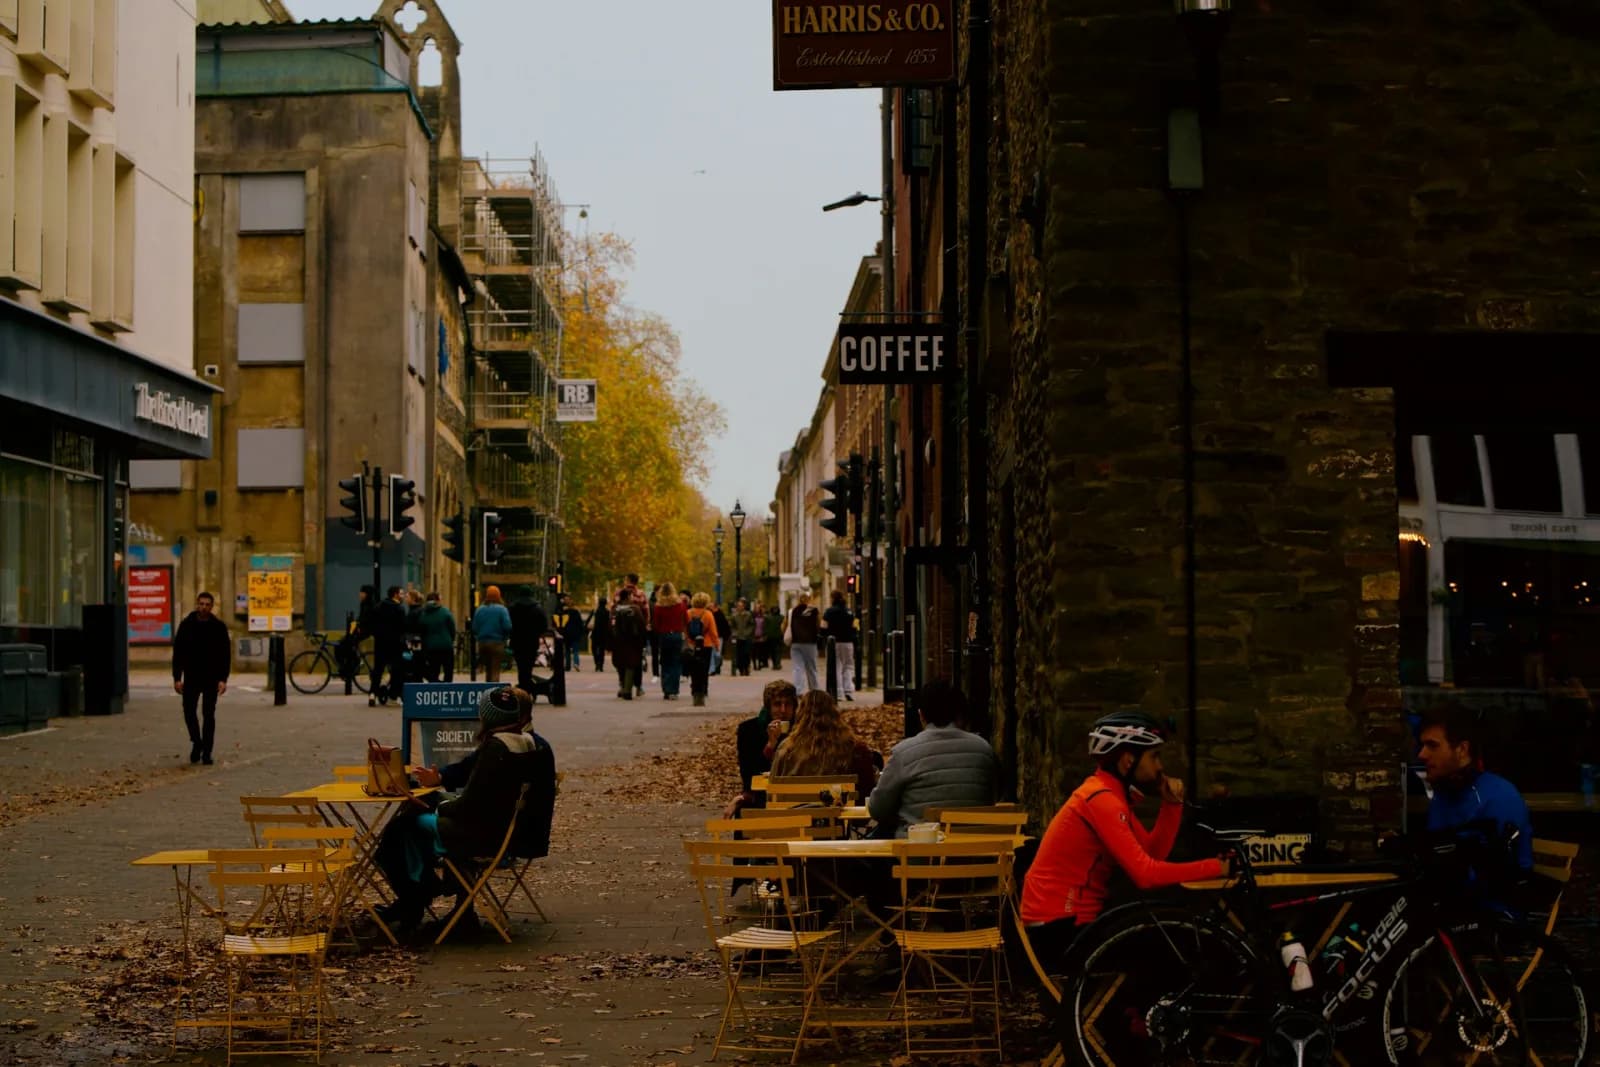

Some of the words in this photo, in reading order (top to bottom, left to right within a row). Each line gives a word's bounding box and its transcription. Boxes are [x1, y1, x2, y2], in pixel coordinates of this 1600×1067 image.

[796, 47, 893, 66] Established
[904, 47, 938, 65] 1855
[840, 335, 944, 372] COFFEE
[563, 384, 589, 403] RB
[251, 576, 267, 585] FOR
[269, 576, 288, 585] SALE
[416, 690, 464, 706] SOCIETY
[468, 690, 482, 706] CA
[436, 730, 474, 743] SOCIETY
[1249, 842, 1305, 863] SING
[1361, 895, 1409, 957] ndale
[1322, 918, 1409, 1022] FOCUS
